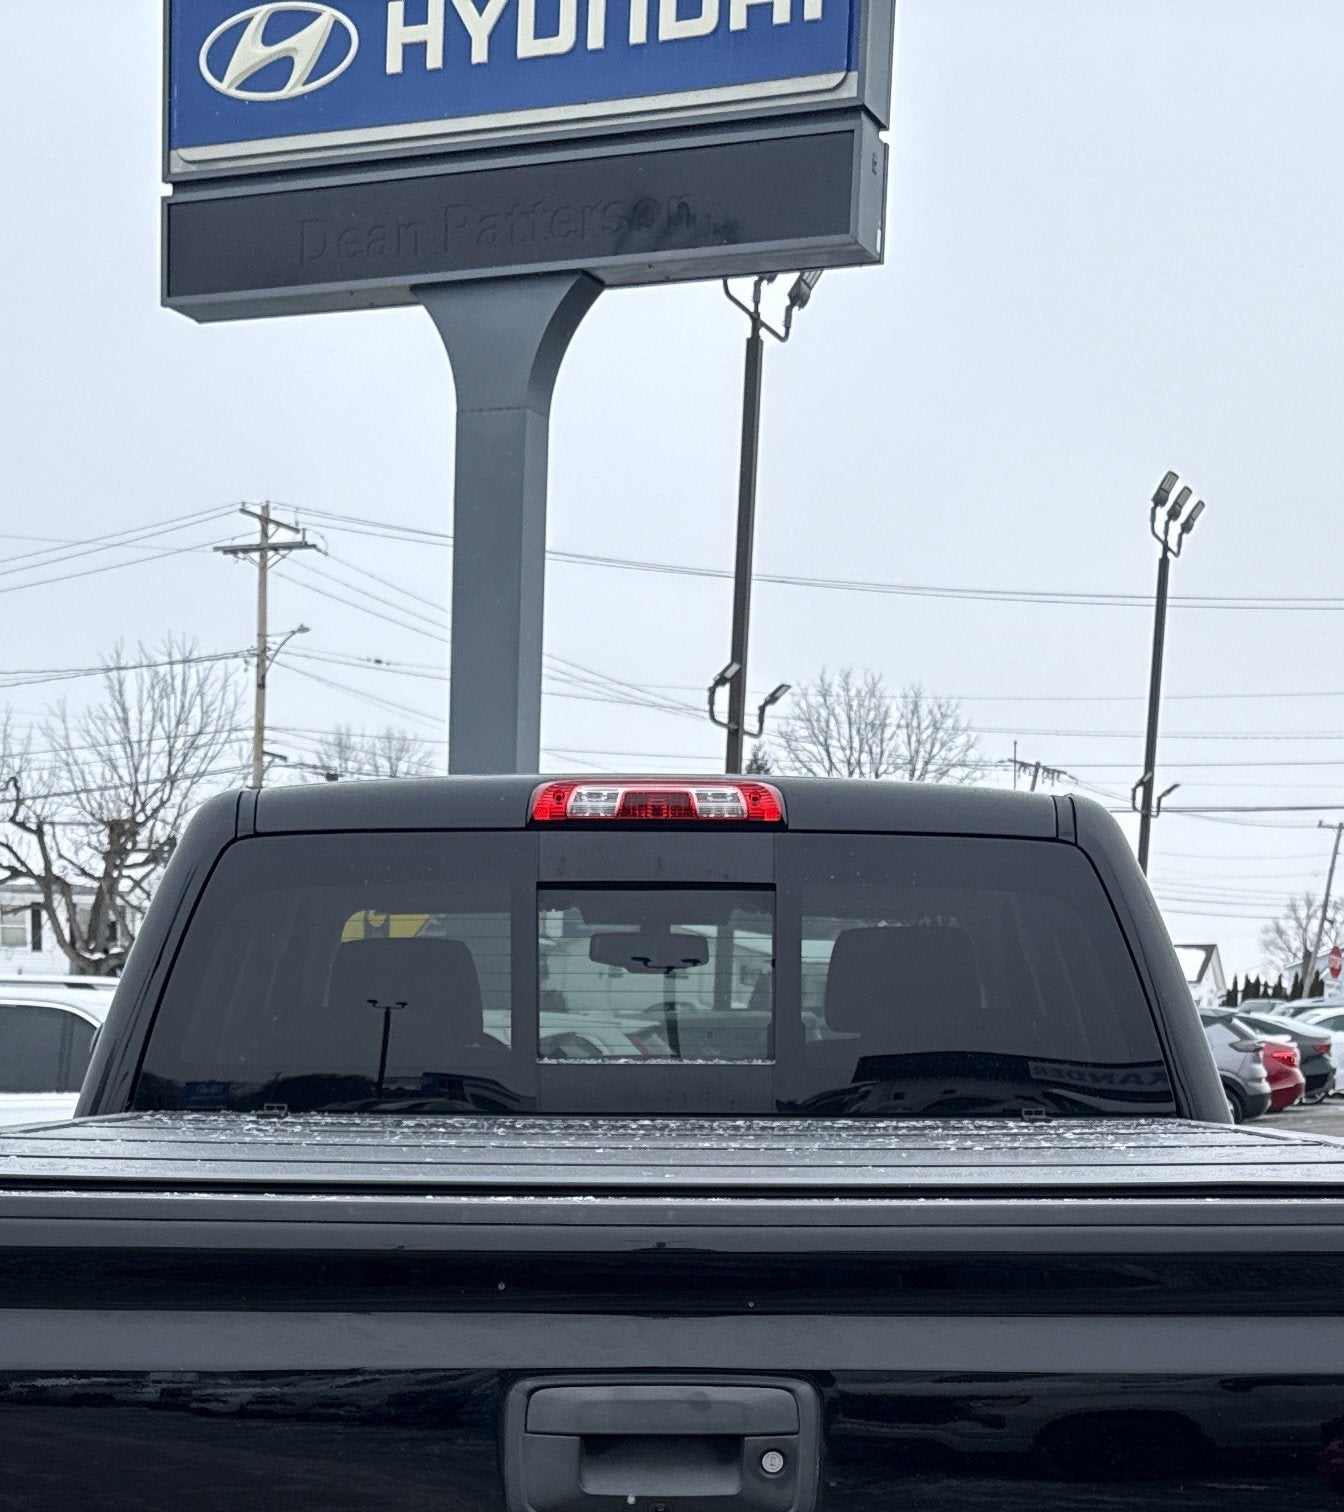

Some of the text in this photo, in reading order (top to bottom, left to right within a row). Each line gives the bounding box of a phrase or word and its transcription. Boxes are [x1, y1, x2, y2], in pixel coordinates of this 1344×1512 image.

[386, 0, 823, 74] HYUND
[299, 194, 691, 265] Dean Patterson
